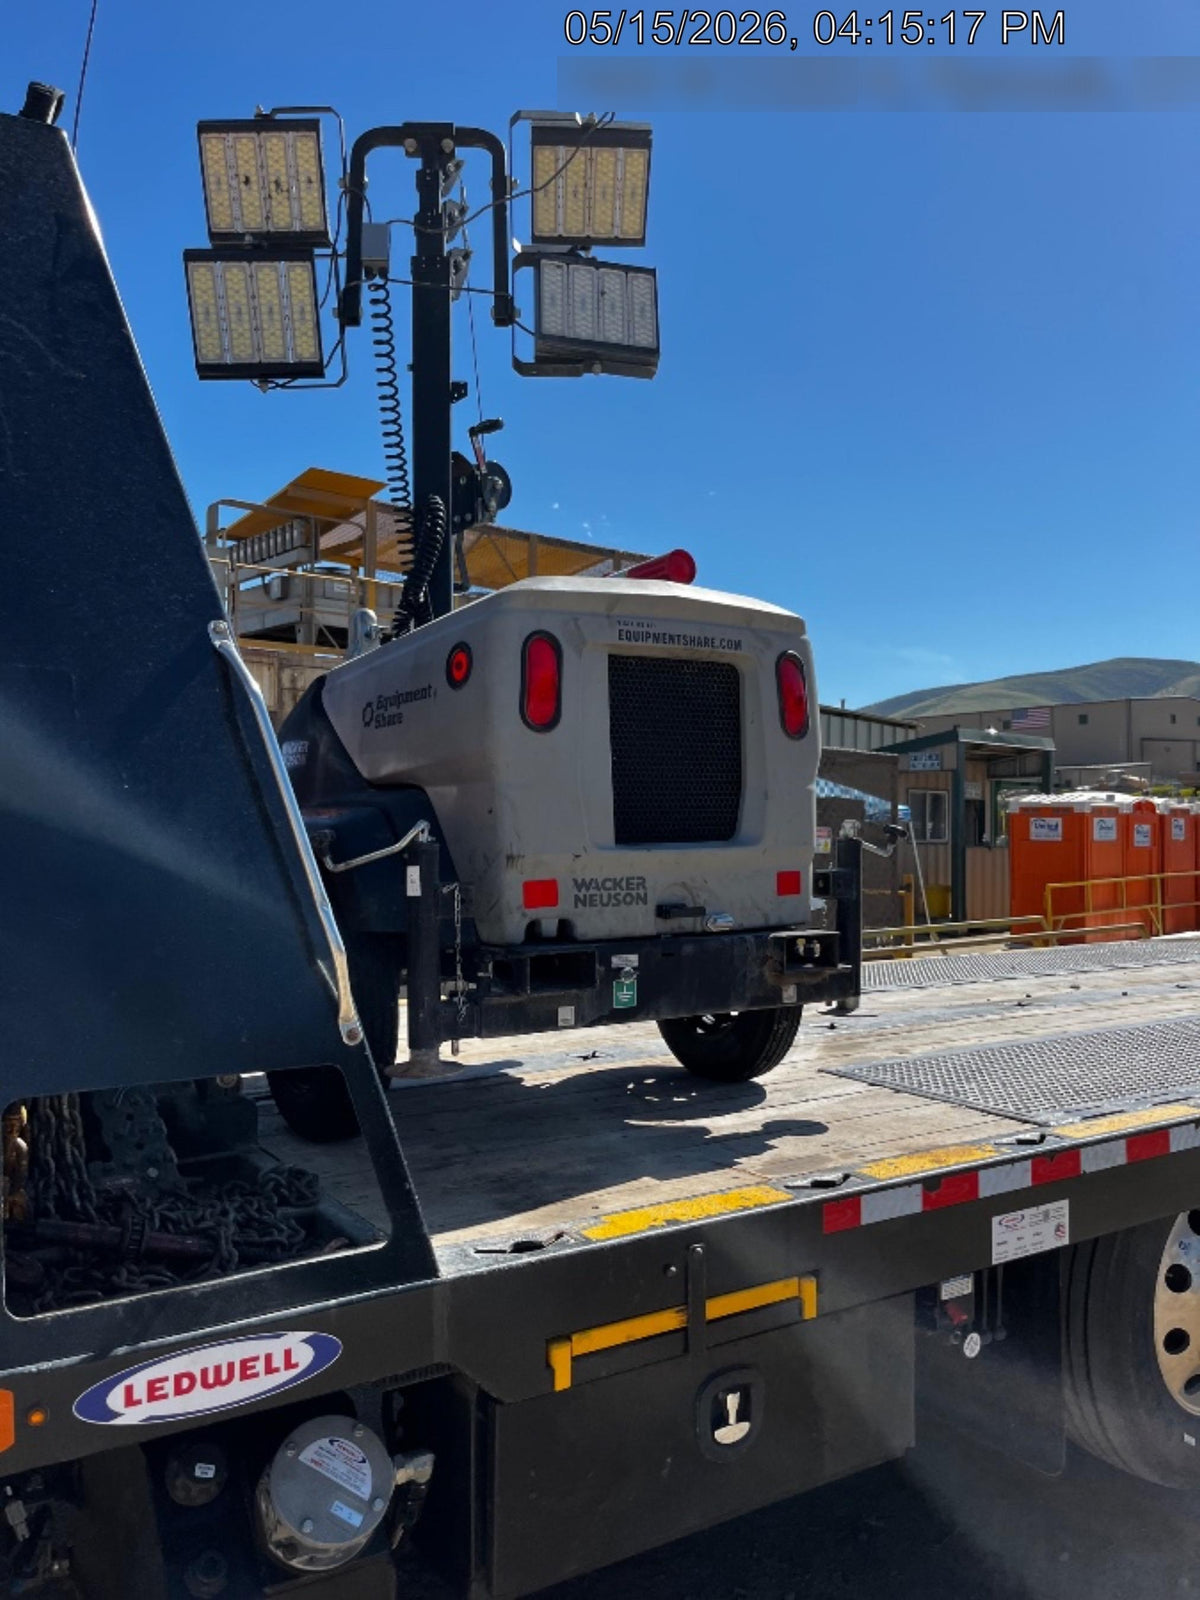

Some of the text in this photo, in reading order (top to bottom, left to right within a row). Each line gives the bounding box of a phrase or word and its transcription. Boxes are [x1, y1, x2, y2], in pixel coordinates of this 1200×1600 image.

[617, 628, 743, 651] EQUIPMENTSHARE.COM
[376, 683, 433, 711] Equipment
[375, 712, 403, 729] Share
[572, 876, 647, 893] WACKER
[574, 892, 648, 909] NEUSON
[123, 1347, 300, 1408] LEDWELL
